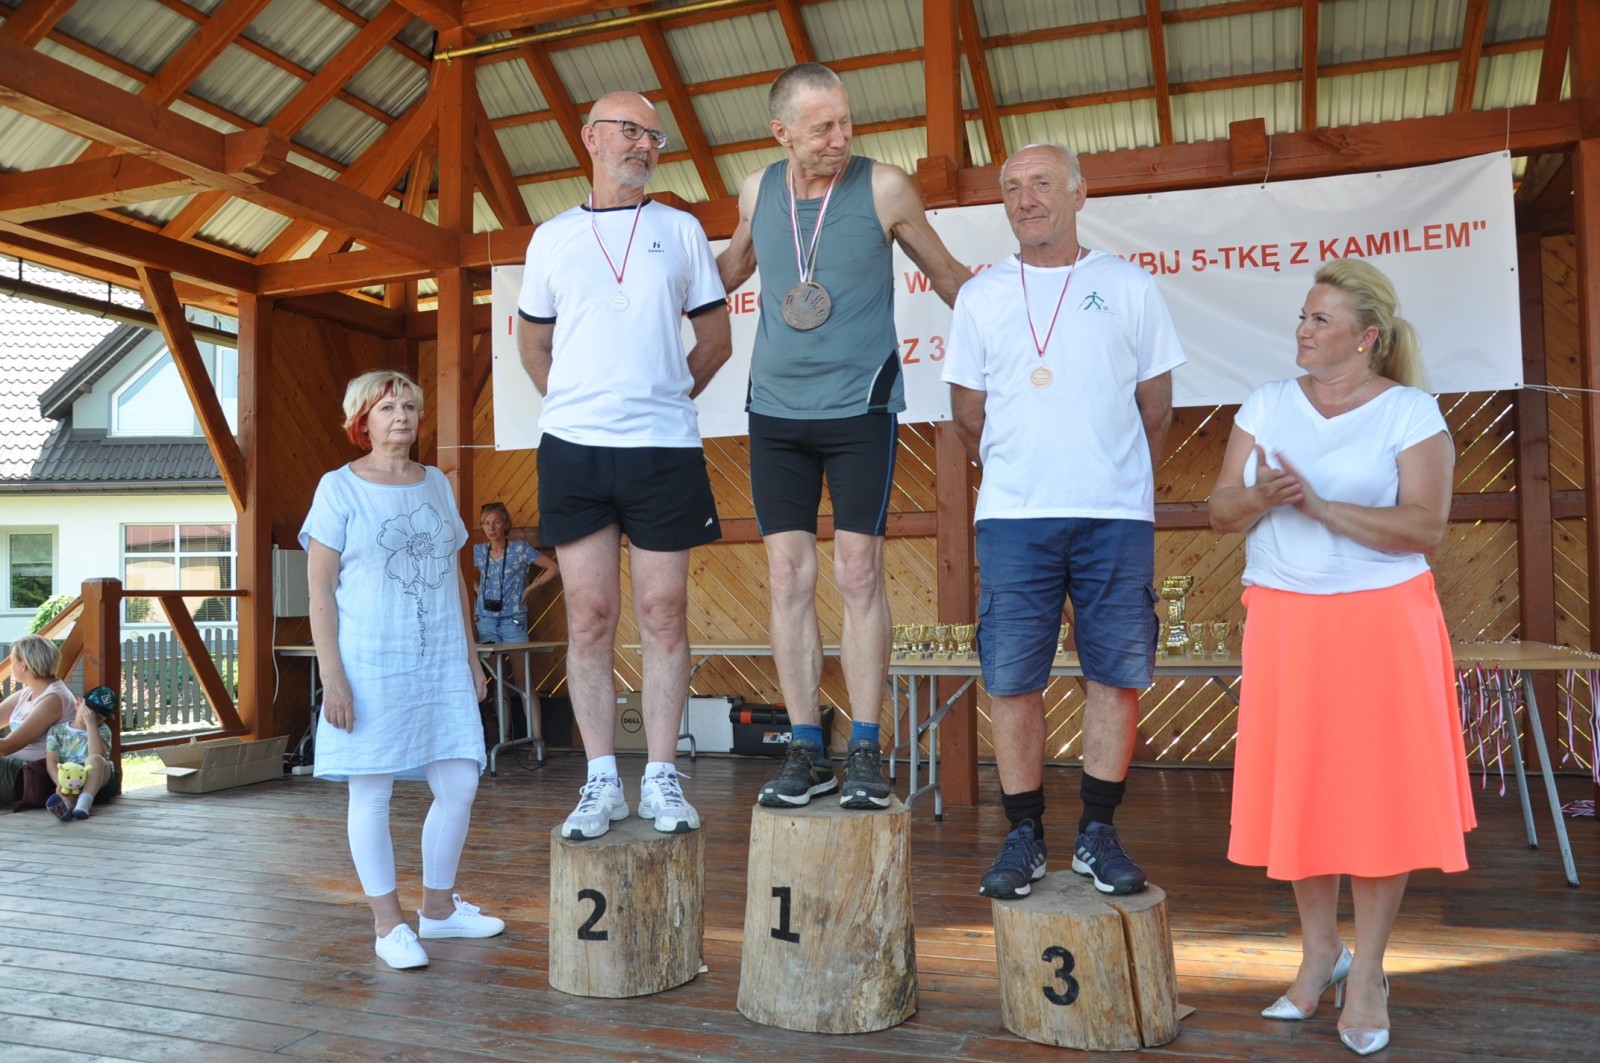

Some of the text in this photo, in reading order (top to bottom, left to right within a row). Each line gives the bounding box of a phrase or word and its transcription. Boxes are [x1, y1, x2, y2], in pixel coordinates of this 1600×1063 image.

[1191, 243, 1281, 272] 5-TKĘ
[1290, 241, 1309, 265] Z
[623, 717, 641, 725] DELL
[577, 888, 609, 942] 2
[771, 886, 800, 943] 1
[1042, 946, 1080, 1006] 3
